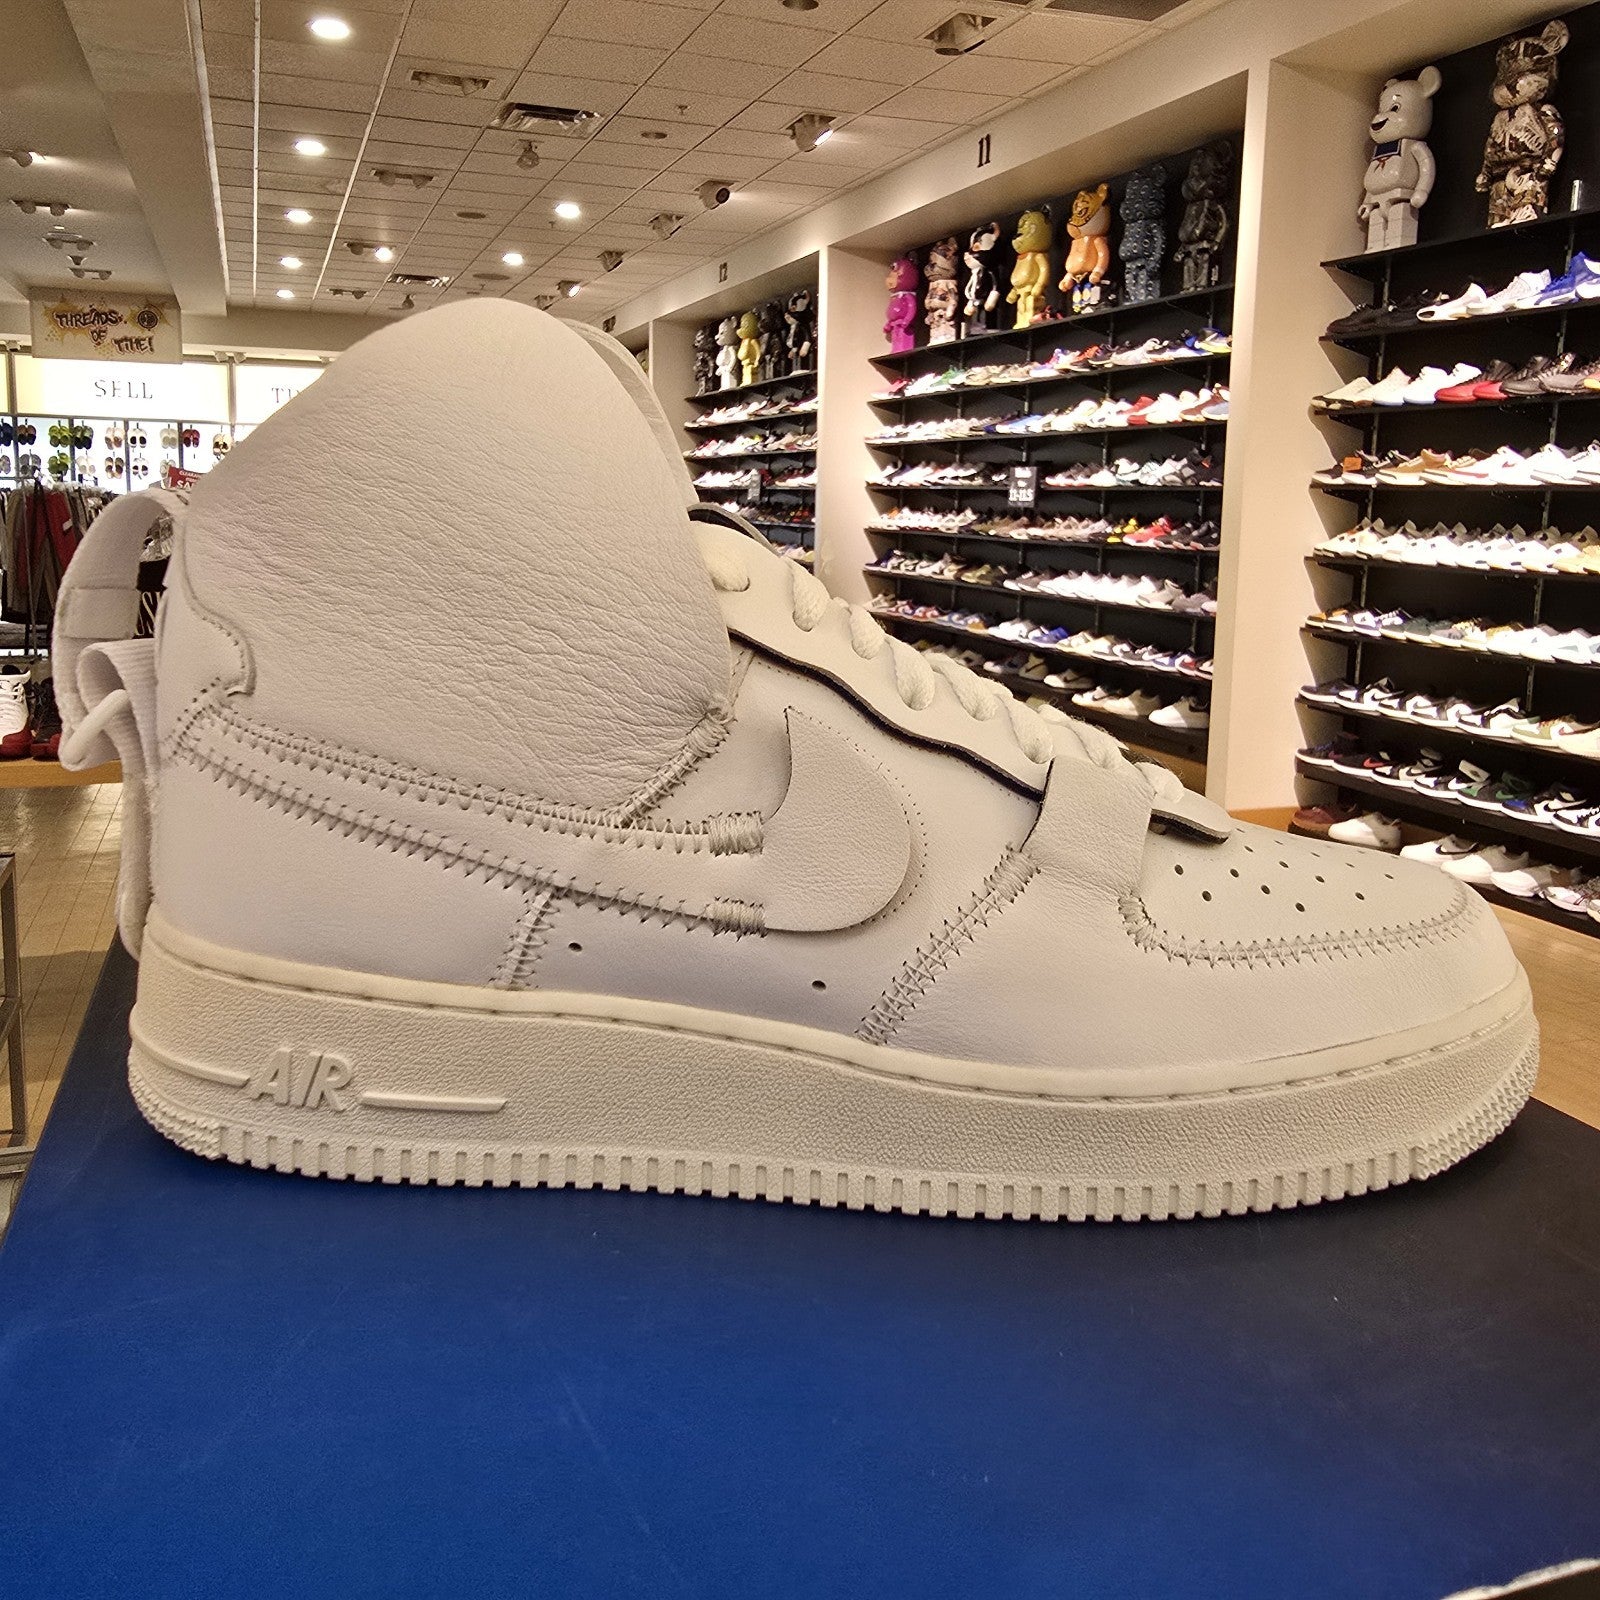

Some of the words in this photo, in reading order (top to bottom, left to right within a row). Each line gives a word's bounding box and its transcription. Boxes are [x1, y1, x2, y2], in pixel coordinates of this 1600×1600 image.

[977, 133, 991, 168] 11
[94, 379, 153, 399] SELL
[250, 1048, 353, 1113] AIR
